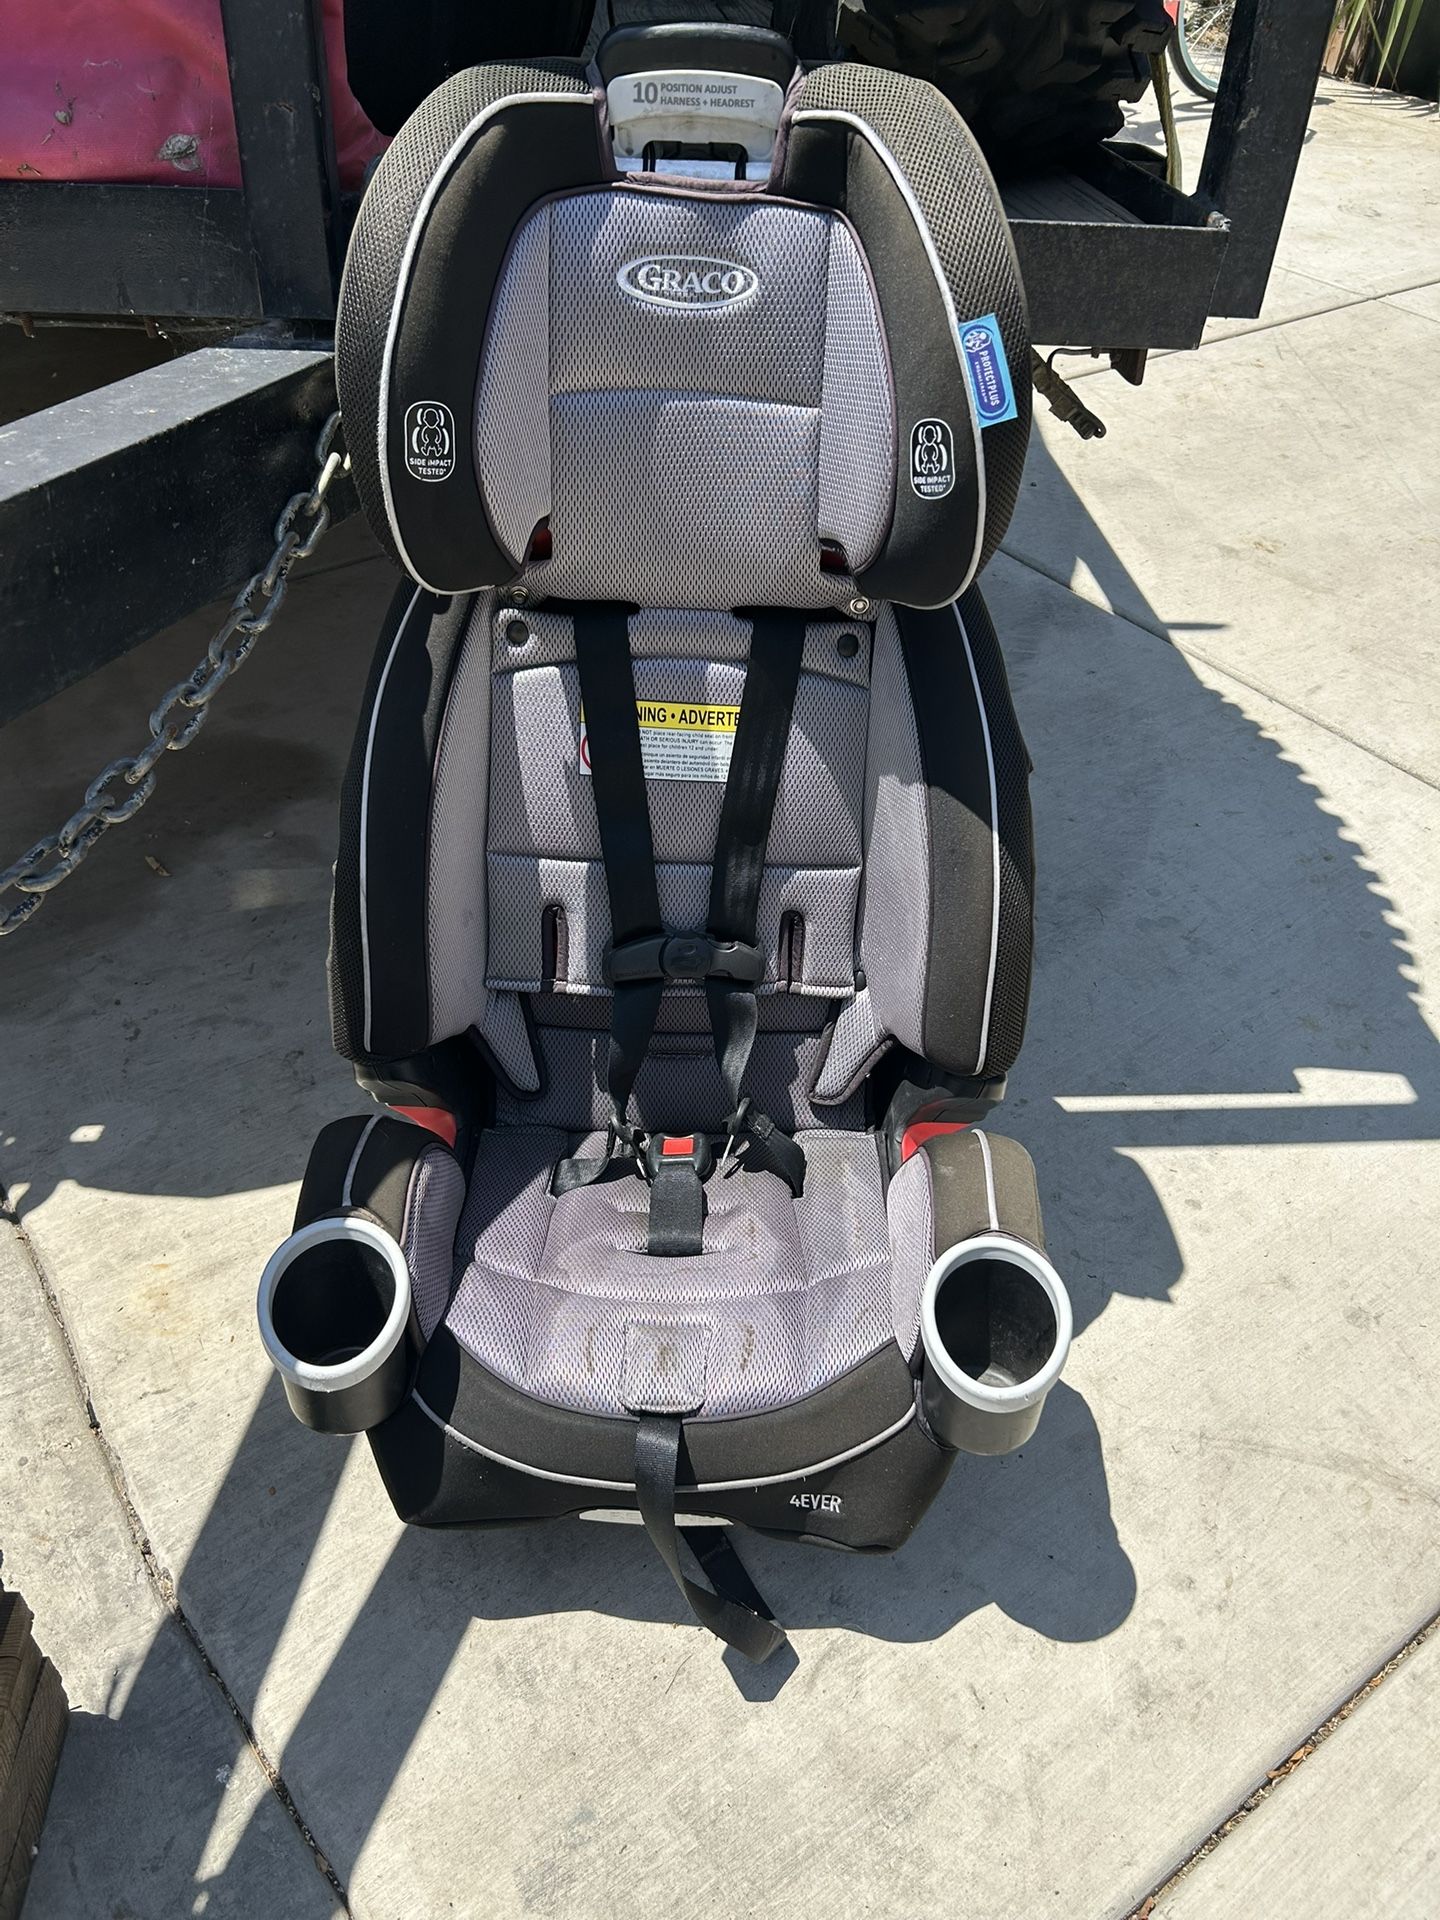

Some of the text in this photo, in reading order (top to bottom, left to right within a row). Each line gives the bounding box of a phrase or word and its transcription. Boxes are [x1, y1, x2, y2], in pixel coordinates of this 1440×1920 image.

[632, 82, 738, 104] 10 POSITION ADJUST
[660, 96, 701, 106] HARNESS
[710, 98, 755, 108] HEADREST
[637, 264, 745, 295] GRACO
[979, 350, 1000, 406] PROTECTPLUS
[409, 457, 451, 467] SIDE IMPACT
[913, 475, 951, 484] SIDE IMPACT
[789, 1494, 842, 1513] 4EVER
